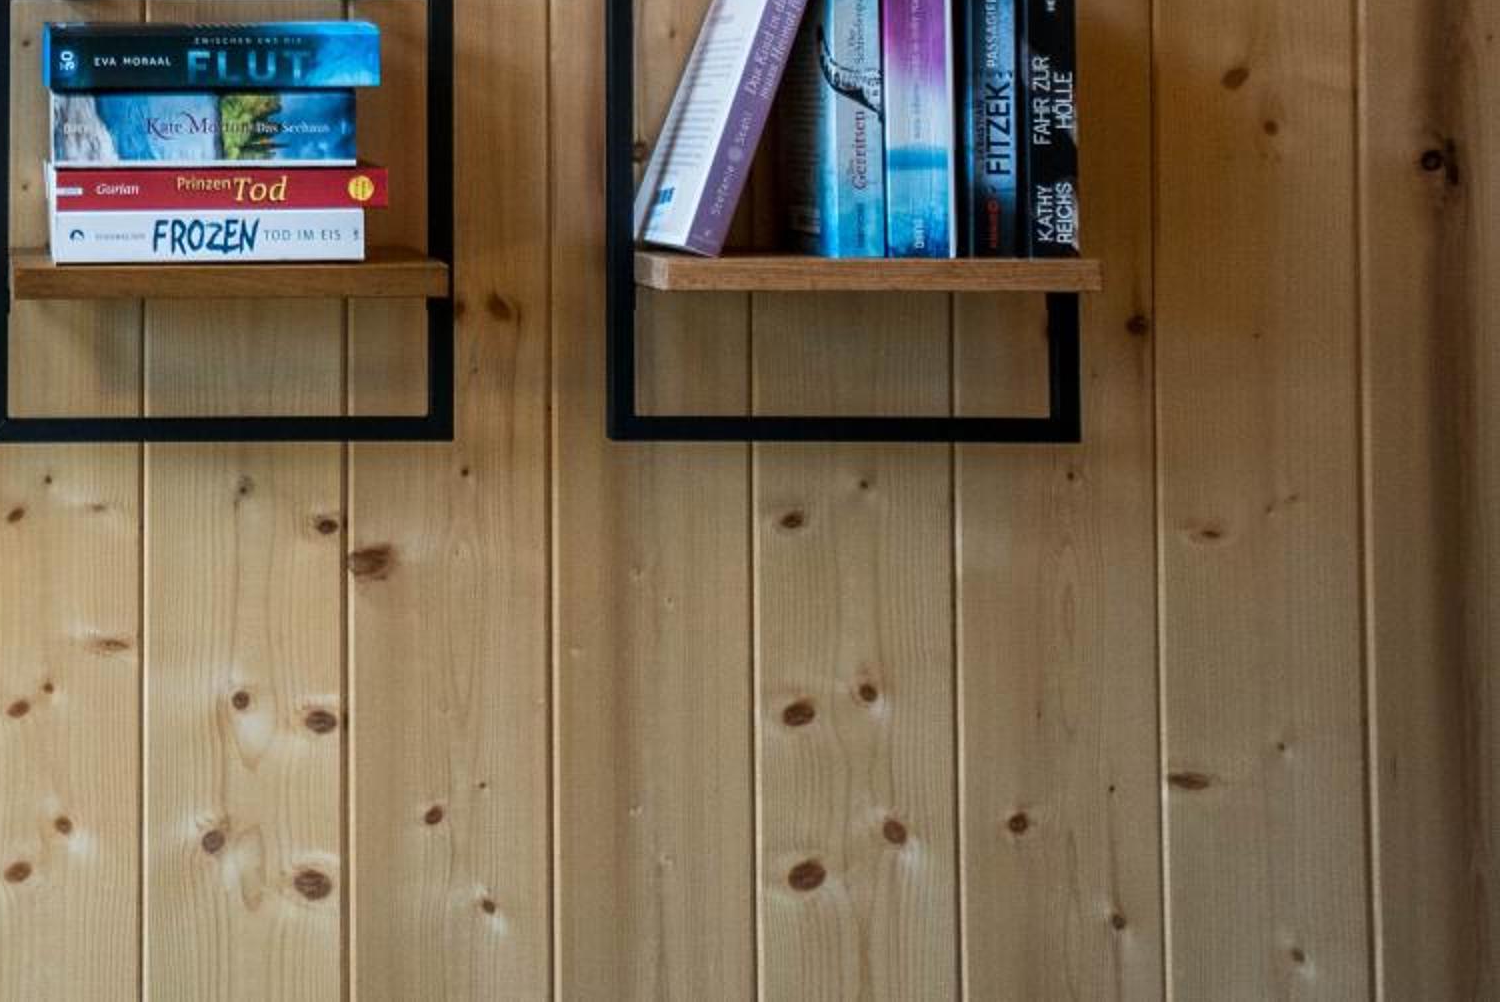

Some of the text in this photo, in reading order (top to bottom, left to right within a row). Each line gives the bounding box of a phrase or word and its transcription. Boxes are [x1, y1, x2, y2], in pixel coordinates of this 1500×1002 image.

[94, 56, 172, 68] EVA MORAAL
[187, 49, 311, 83] FLUT
[1032, 55, 1051, 145] FAHR ZUR
[1052, 71, 1073, 129] HÖLLE
[146, 117, 182, 140] Kate
[256, 122, 278, 134] Das
[852, 111, 867, 190] Gerritsen
[985, 81, 1011, 175] FITZEK
[177, 175, 288, 202] Prinzen Tod
[1037, 185, 1053, 242] KATHY
[1056, 181, 1073, 244] REICHS
[153, 218, 260, 255] FROZEN
[263, 229, 292, 241] TOD
[297, 229, 315, 241] IM
[321, 229, 341, 241] EIS
